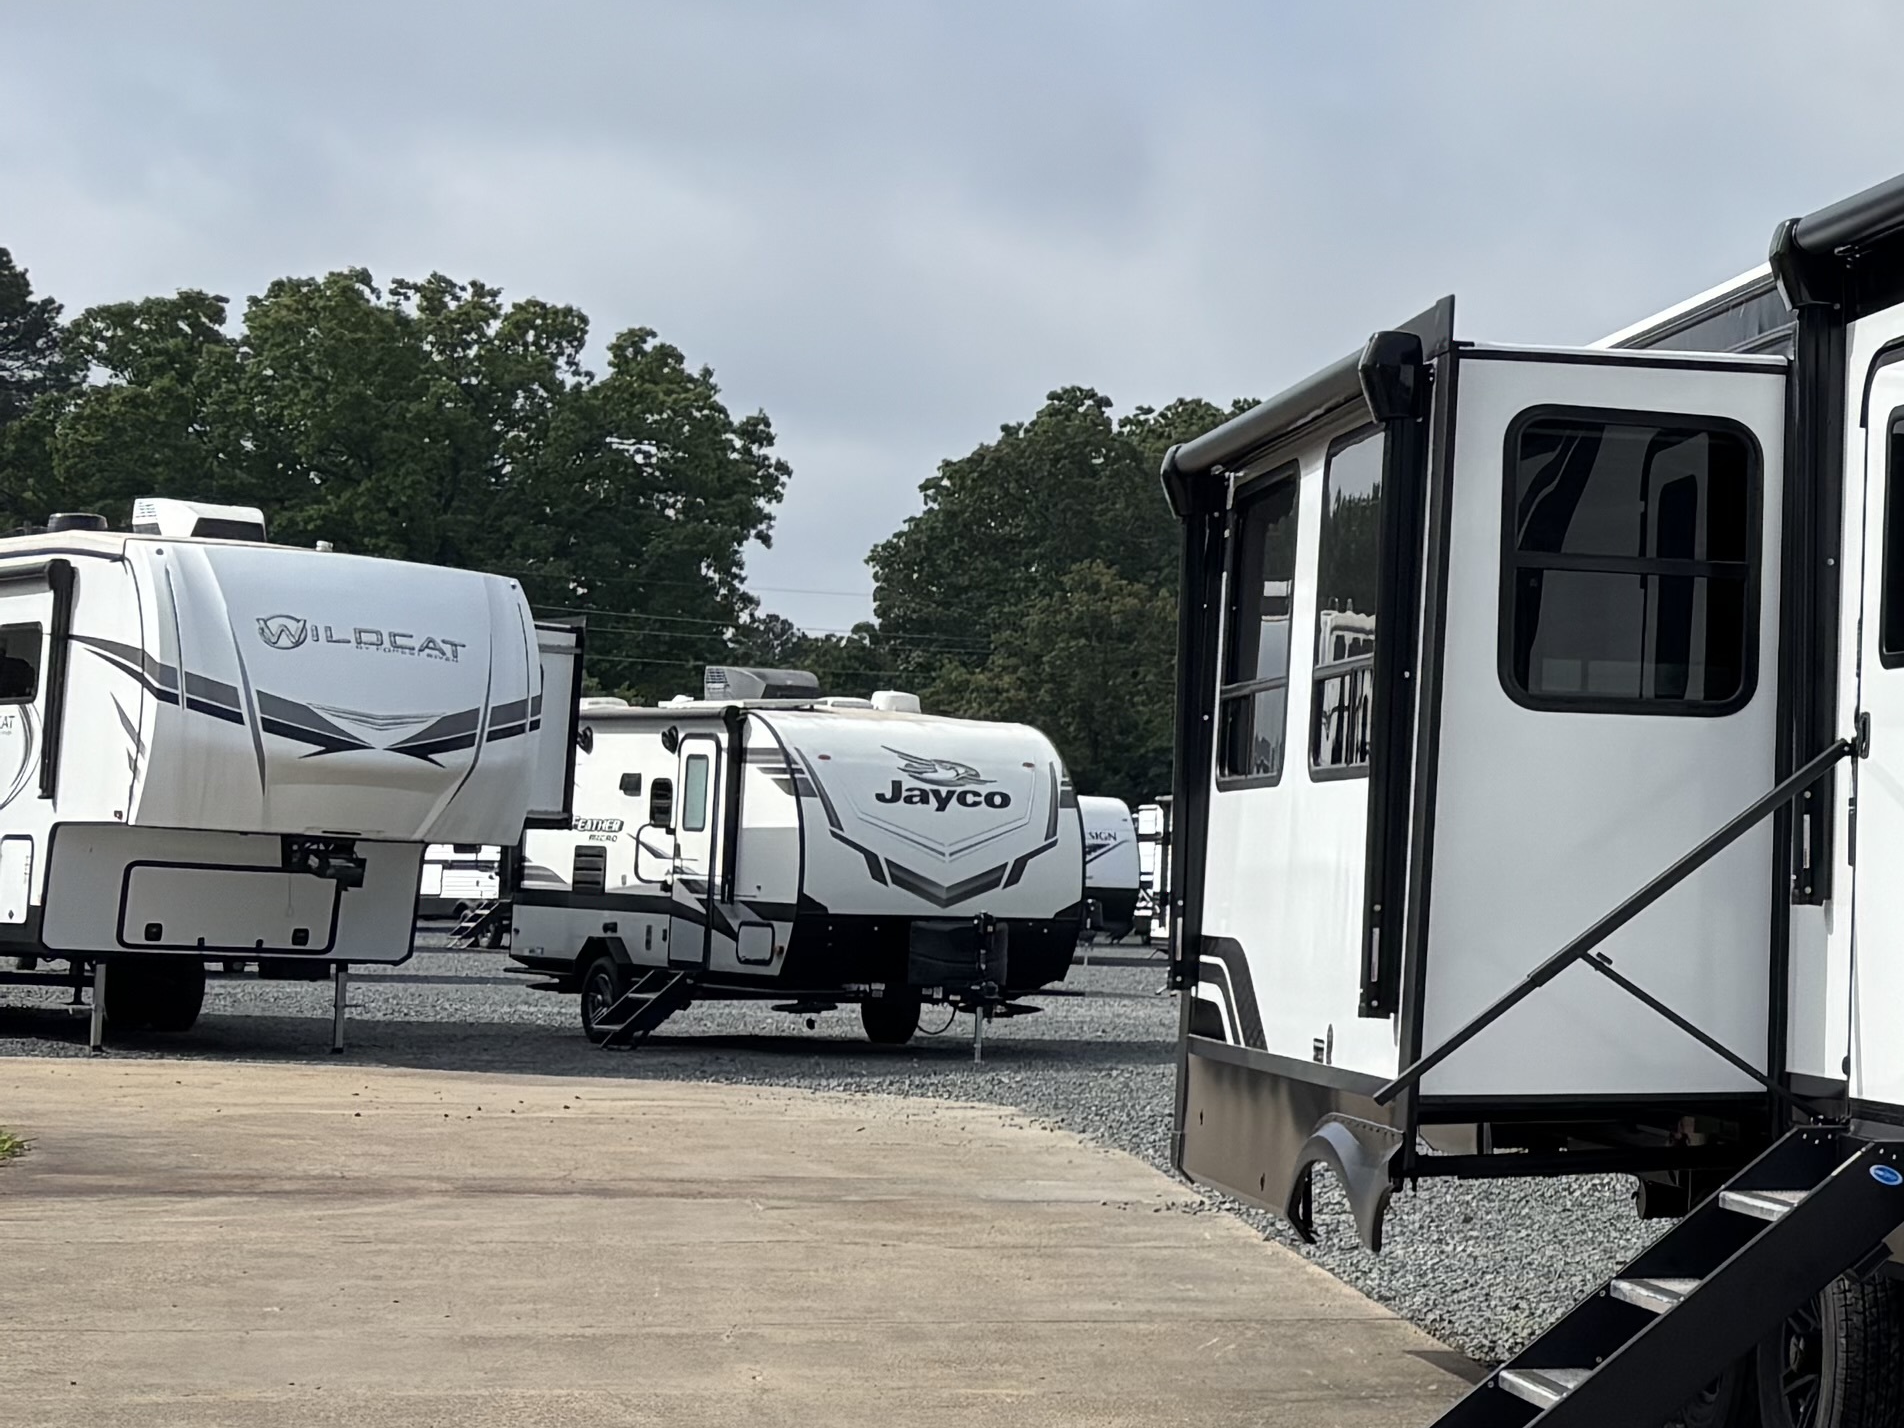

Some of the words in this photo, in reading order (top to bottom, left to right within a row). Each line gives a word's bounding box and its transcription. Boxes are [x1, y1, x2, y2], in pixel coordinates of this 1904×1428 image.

[256, 614, 466, 659] WILDCAT
[875, 780, 1011, 812] Jayco
[588, 833, 618, 842] MICRO
